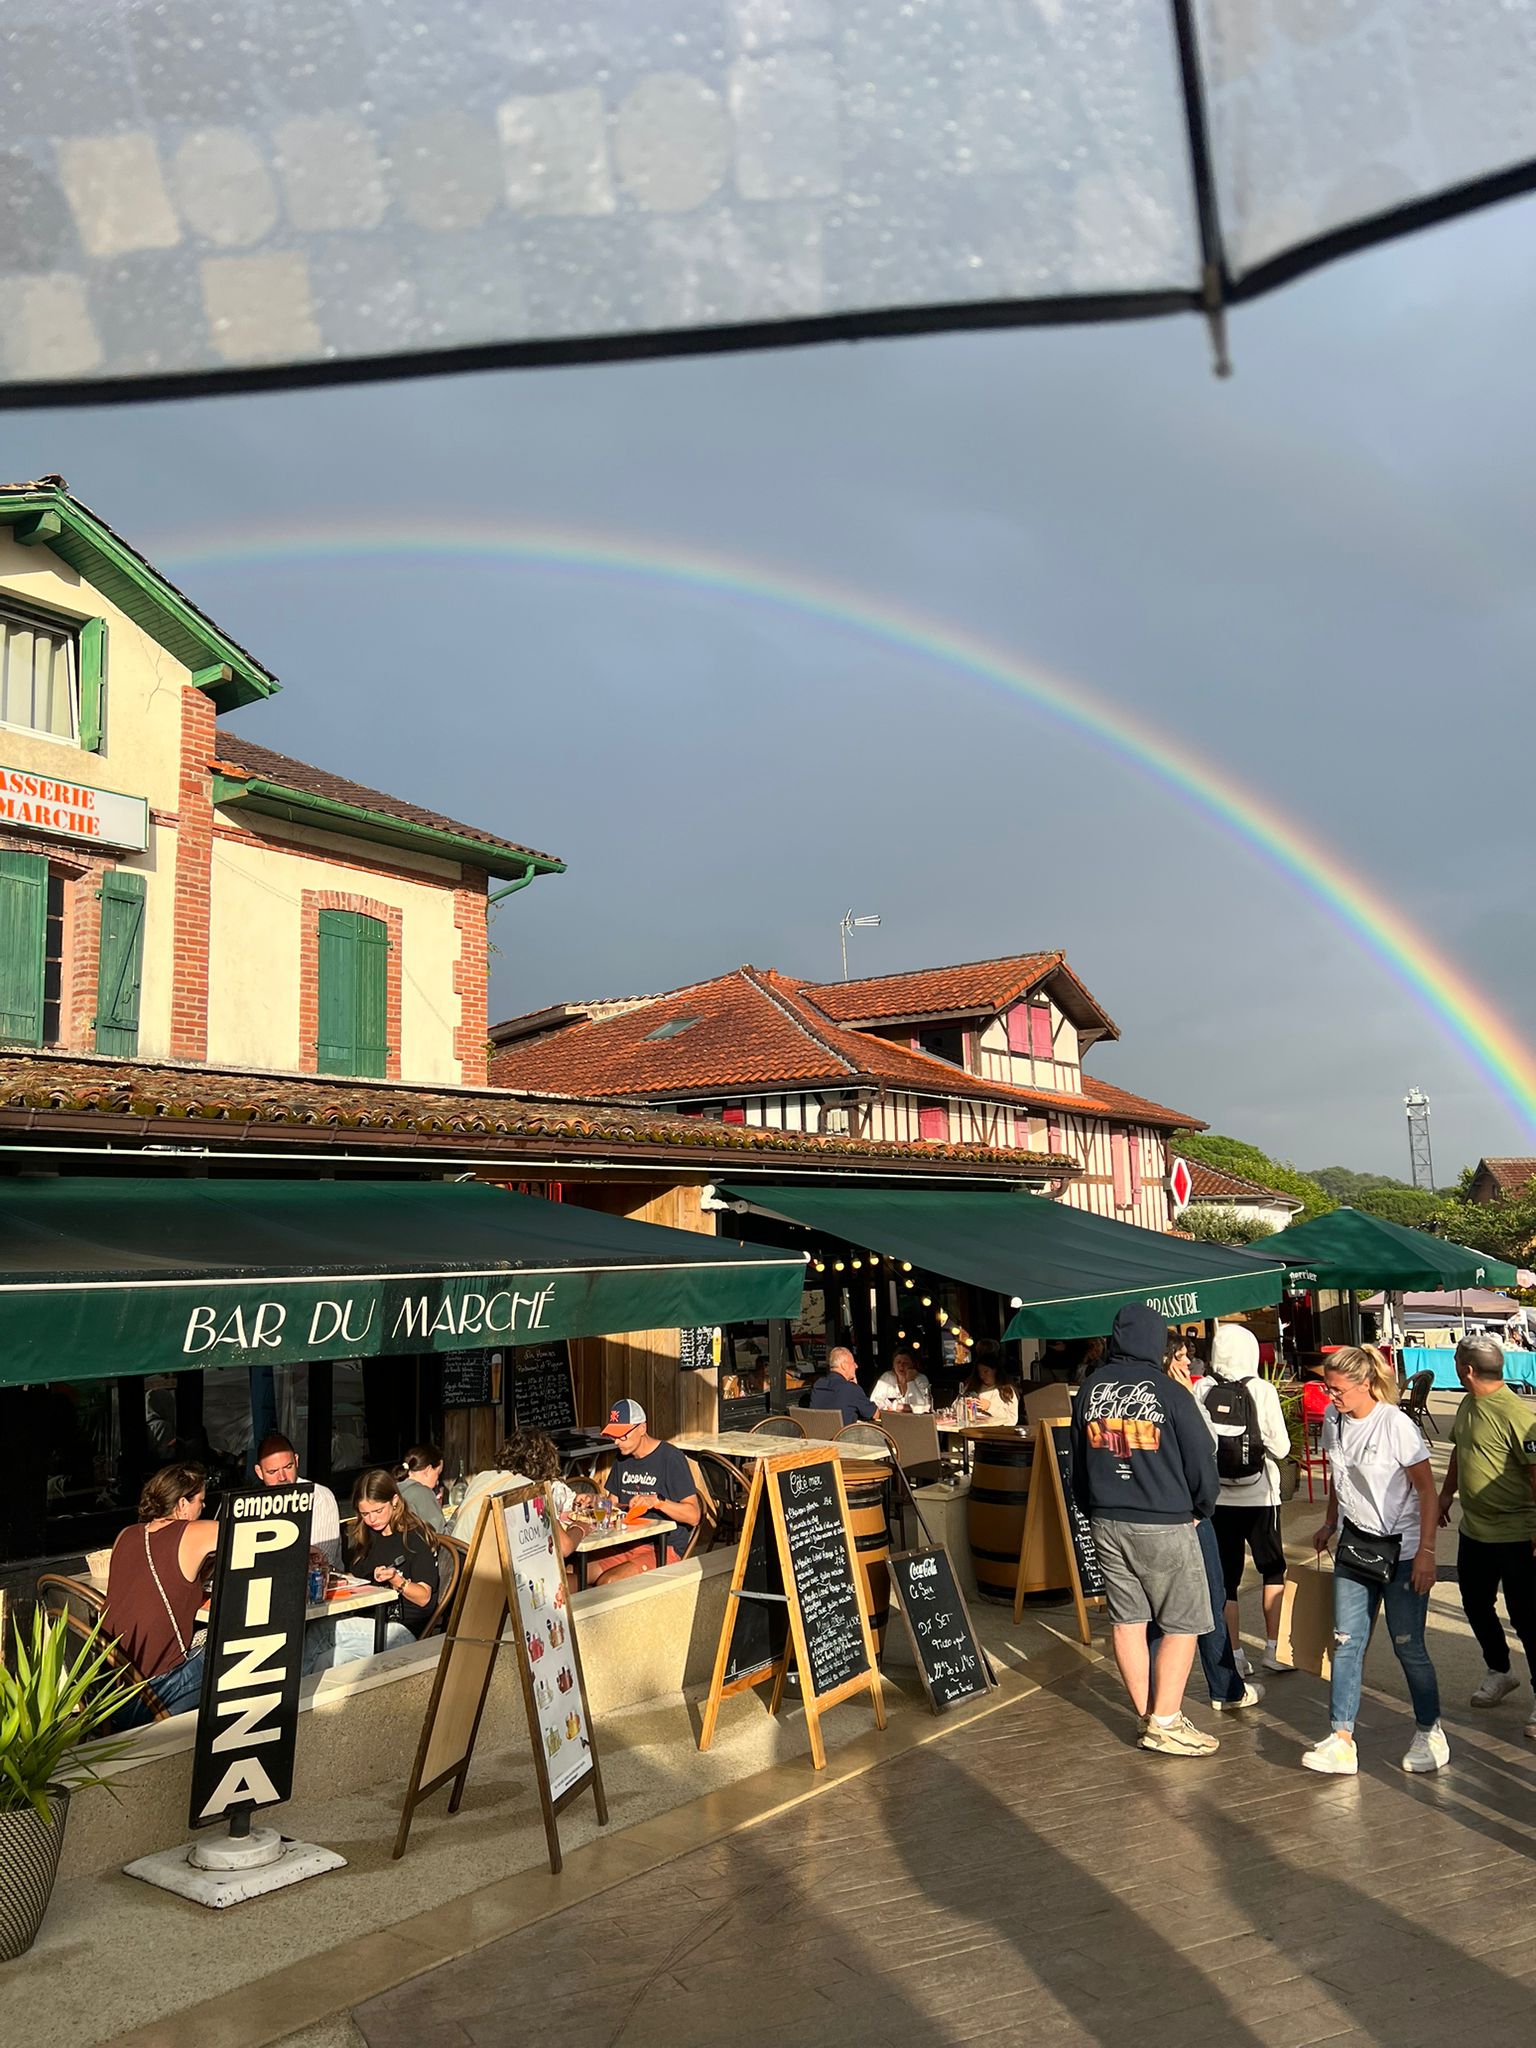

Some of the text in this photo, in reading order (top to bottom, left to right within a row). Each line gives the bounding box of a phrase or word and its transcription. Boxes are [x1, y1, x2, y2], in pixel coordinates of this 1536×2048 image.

[183, 1282, 555, 1353] BAR DU MARCHÉ
[1090, 1381, 1162, 1408] The Plan
[1085, 1398, 1167, 1424] Is No Plan
[622, 1471, 657, 1486] Cocorico
[233, 1489, 313, 1519] emporter
[519, 1526, 541, 1545] GROM
[918, 1612, 953, 1636] DJ SET
[199, 1519, 300, 1818] PIZZA
